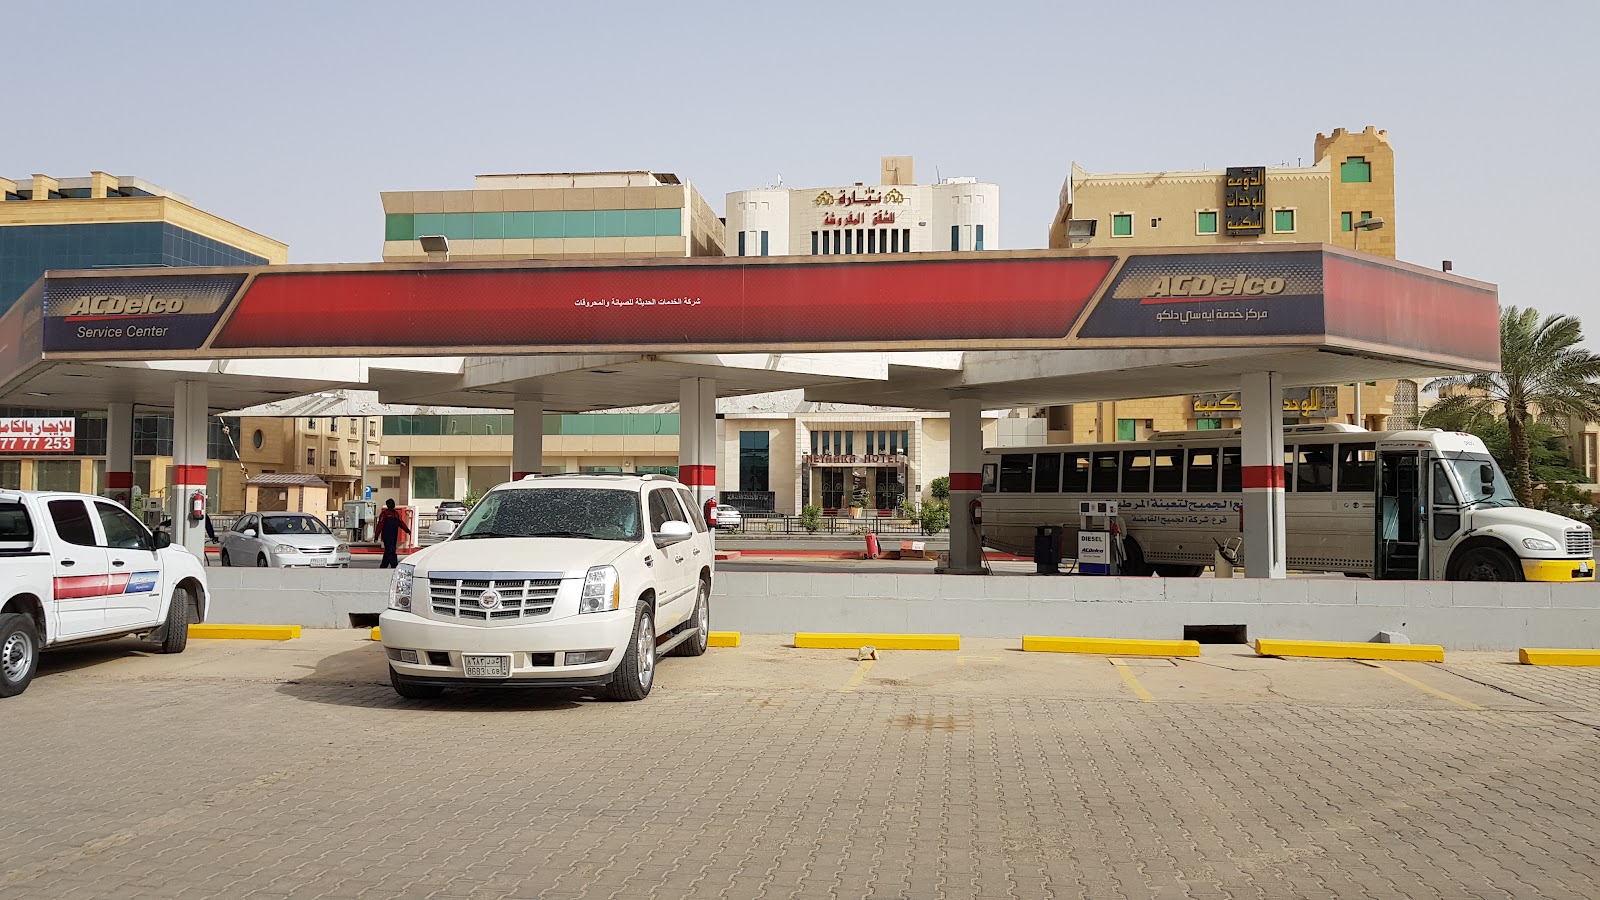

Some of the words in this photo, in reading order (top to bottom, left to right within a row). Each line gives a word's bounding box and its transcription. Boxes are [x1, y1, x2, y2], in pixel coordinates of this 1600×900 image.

[1226, 190, 1265, 210] للوحدات
[1147, 273, 1286, 298] ACDelco
[71, 294, 184, 316] ACDelco
[658, 297, 682, 305] الخدمات
[683, 296, 701, 307] شركة
[1156, 310, 1180, 322] دلكو
[1216, 308, 1244, 320] خدمة
[1245, 308, 1268, 321] مركز
[77, 326, 123, 339] Service
[126, 325, 169, 338] Center
[0, 419, 34, 436] بالكام
[22, 437, 40, 450] 77
[43, 437, 72, 450] 253
[864, 454, 900, 464] HOTEL
[1189, 515, 1209, 525] شركة
[1081, 535, 1104, 543] DIESEL
